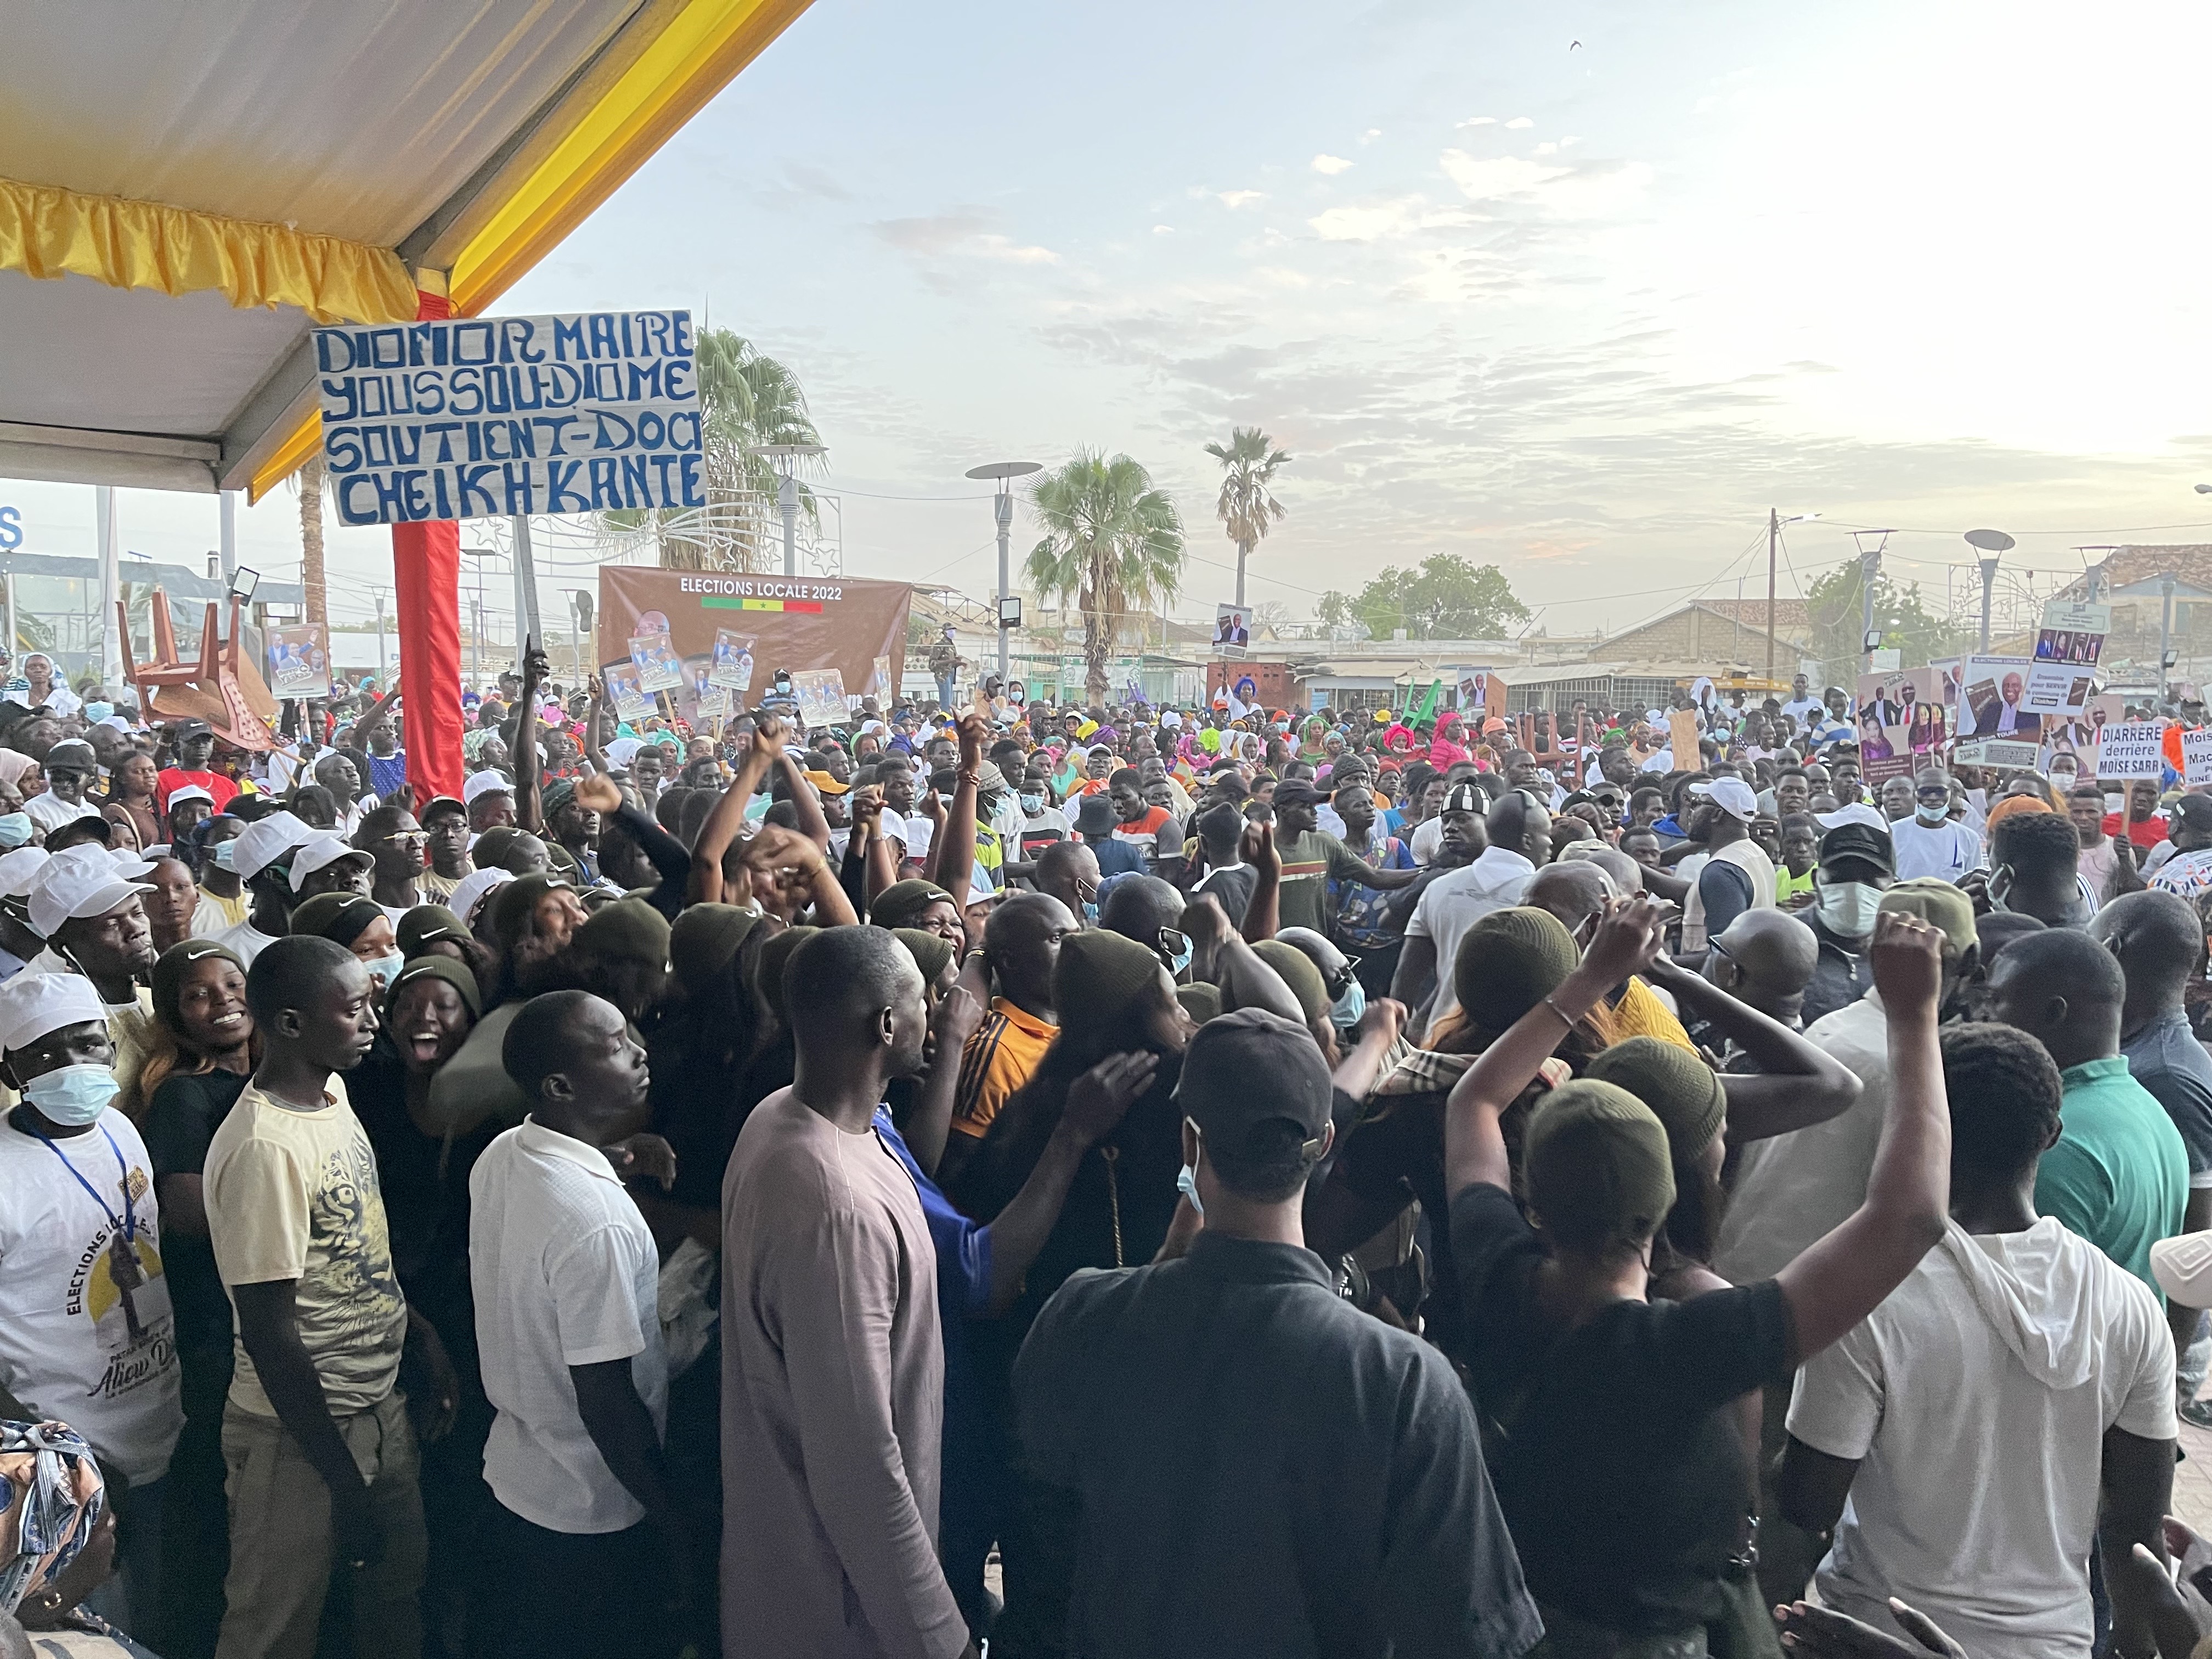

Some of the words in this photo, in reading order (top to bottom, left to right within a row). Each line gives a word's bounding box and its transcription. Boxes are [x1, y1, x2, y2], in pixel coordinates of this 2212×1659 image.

[553, 311, 693, 361] MAIRE
[680, 578, 753, 595] ELECTIONS
[757, 582, 808, 599] LOCALE
[812, 585, 842, 600] 2022
[2132, 760, 2159, 773] SARR
[66, 1231, 107, 1316] ELECTIONS
